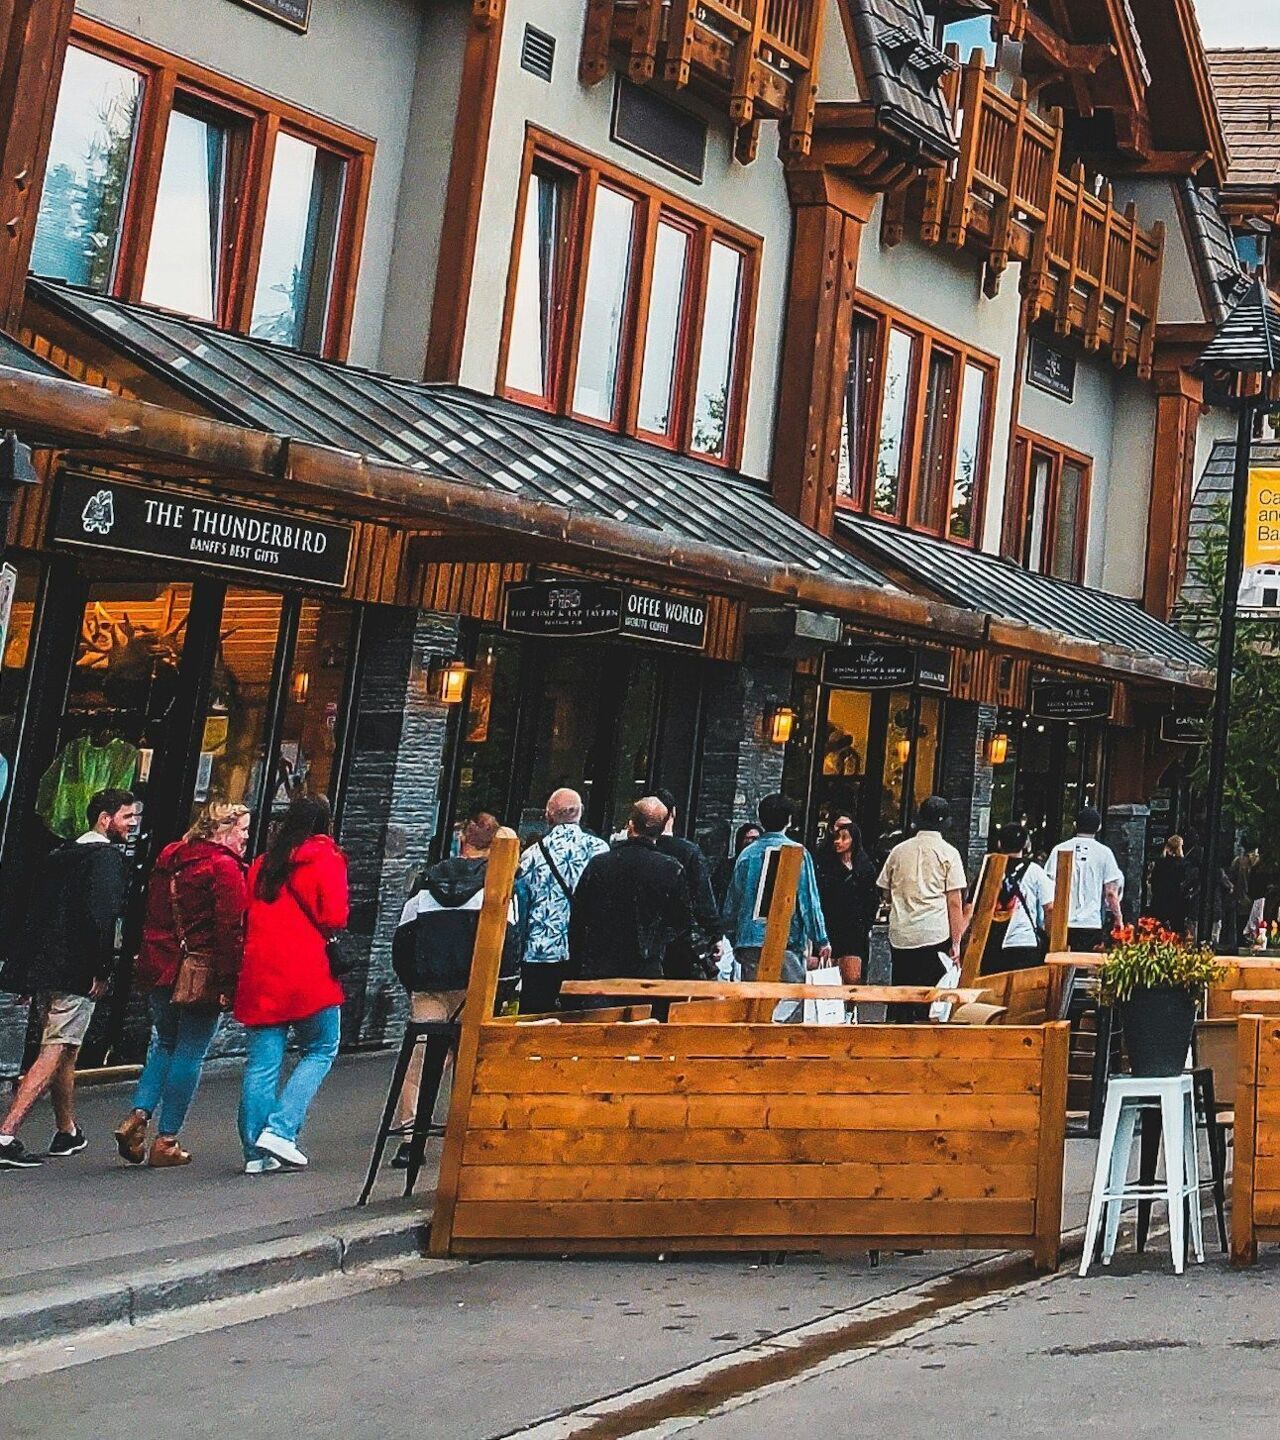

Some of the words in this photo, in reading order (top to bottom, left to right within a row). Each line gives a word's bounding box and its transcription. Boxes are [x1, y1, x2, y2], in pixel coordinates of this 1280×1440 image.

[144, 499, 185, 528] THE
[191, 507, 327, 554] THUNDERBIRD
[190, 537, 227, 555] BANFF'S
[229, 543, 252, 559] BEST
[254, 548, 280, 564] GIFTS
[627, 594, 661, 618] OFFEE
[665, 601, 704, 626] WORLD
